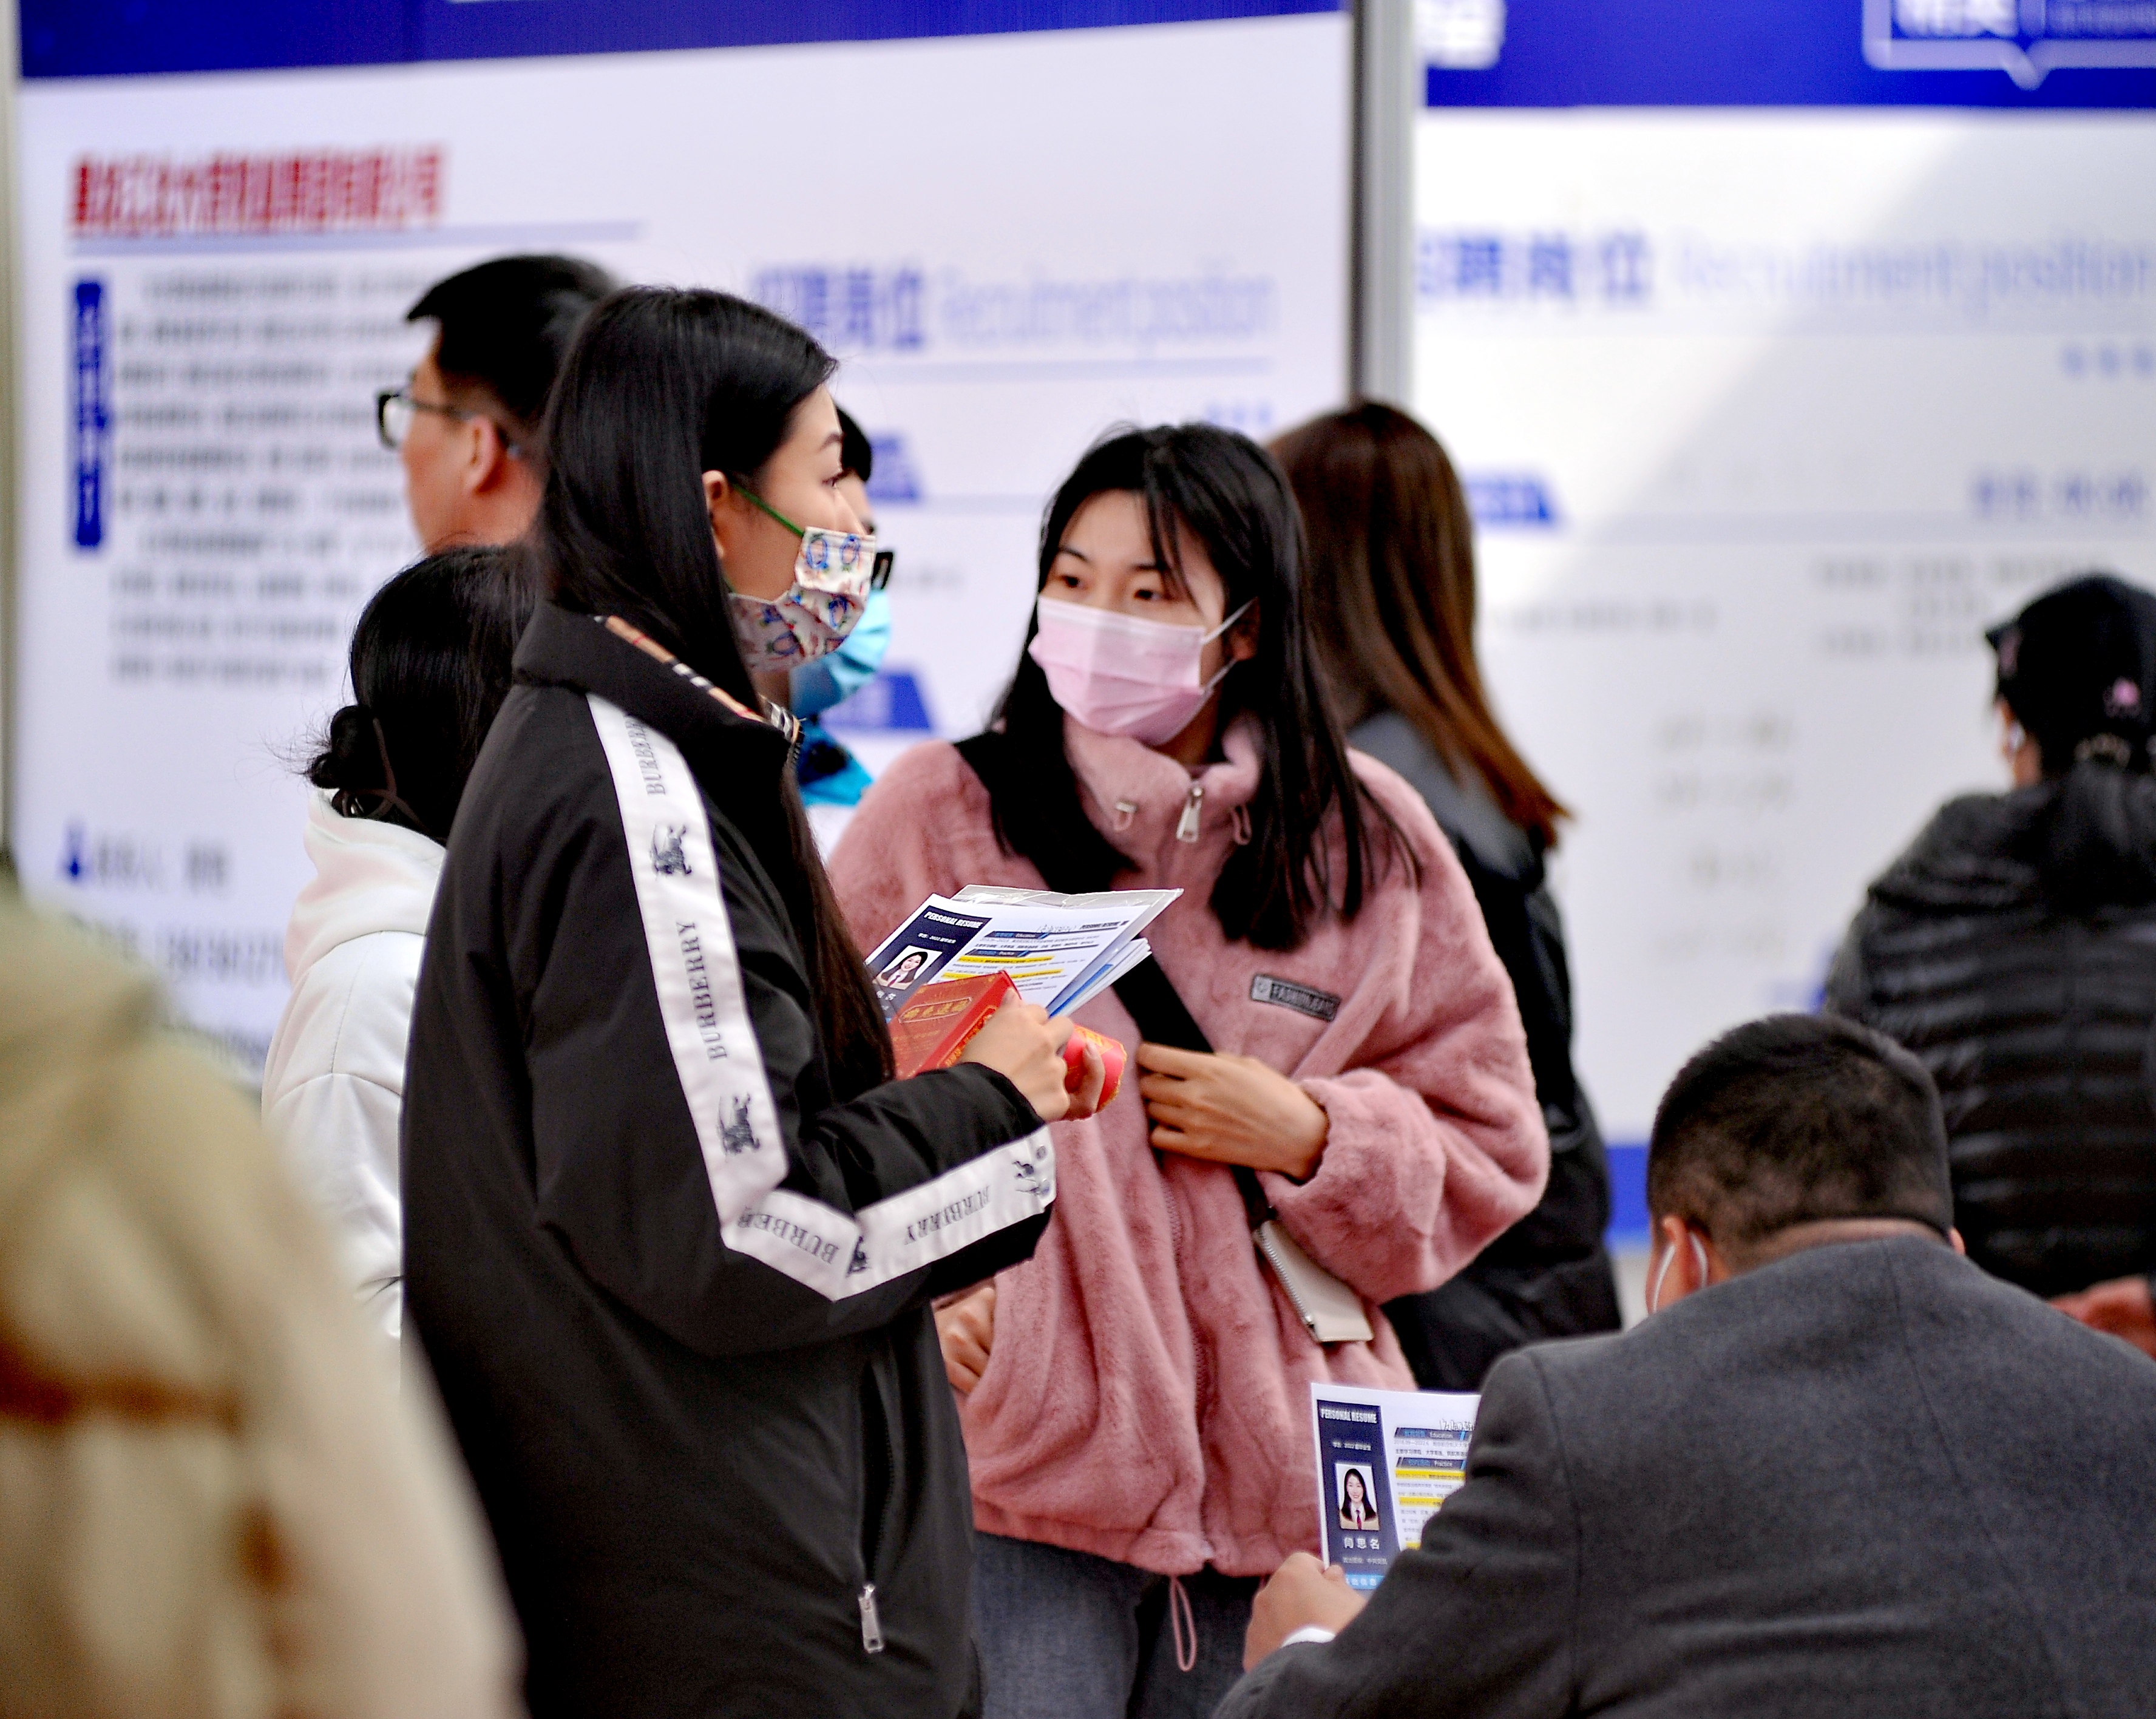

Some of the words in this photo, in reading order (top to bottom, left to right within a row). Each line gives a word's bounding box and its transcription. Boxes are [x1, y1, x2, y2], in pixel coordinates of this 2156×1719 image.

[923, 911, 957, 926] PERSONAL
[955, 918, 983, 929] RESUME
[676, 921, 727, 1060] BURBERRY
[1320, 1408, 1351, 1422] PERSONAL
[1351, 1411, 1377, 1424] RESUME
